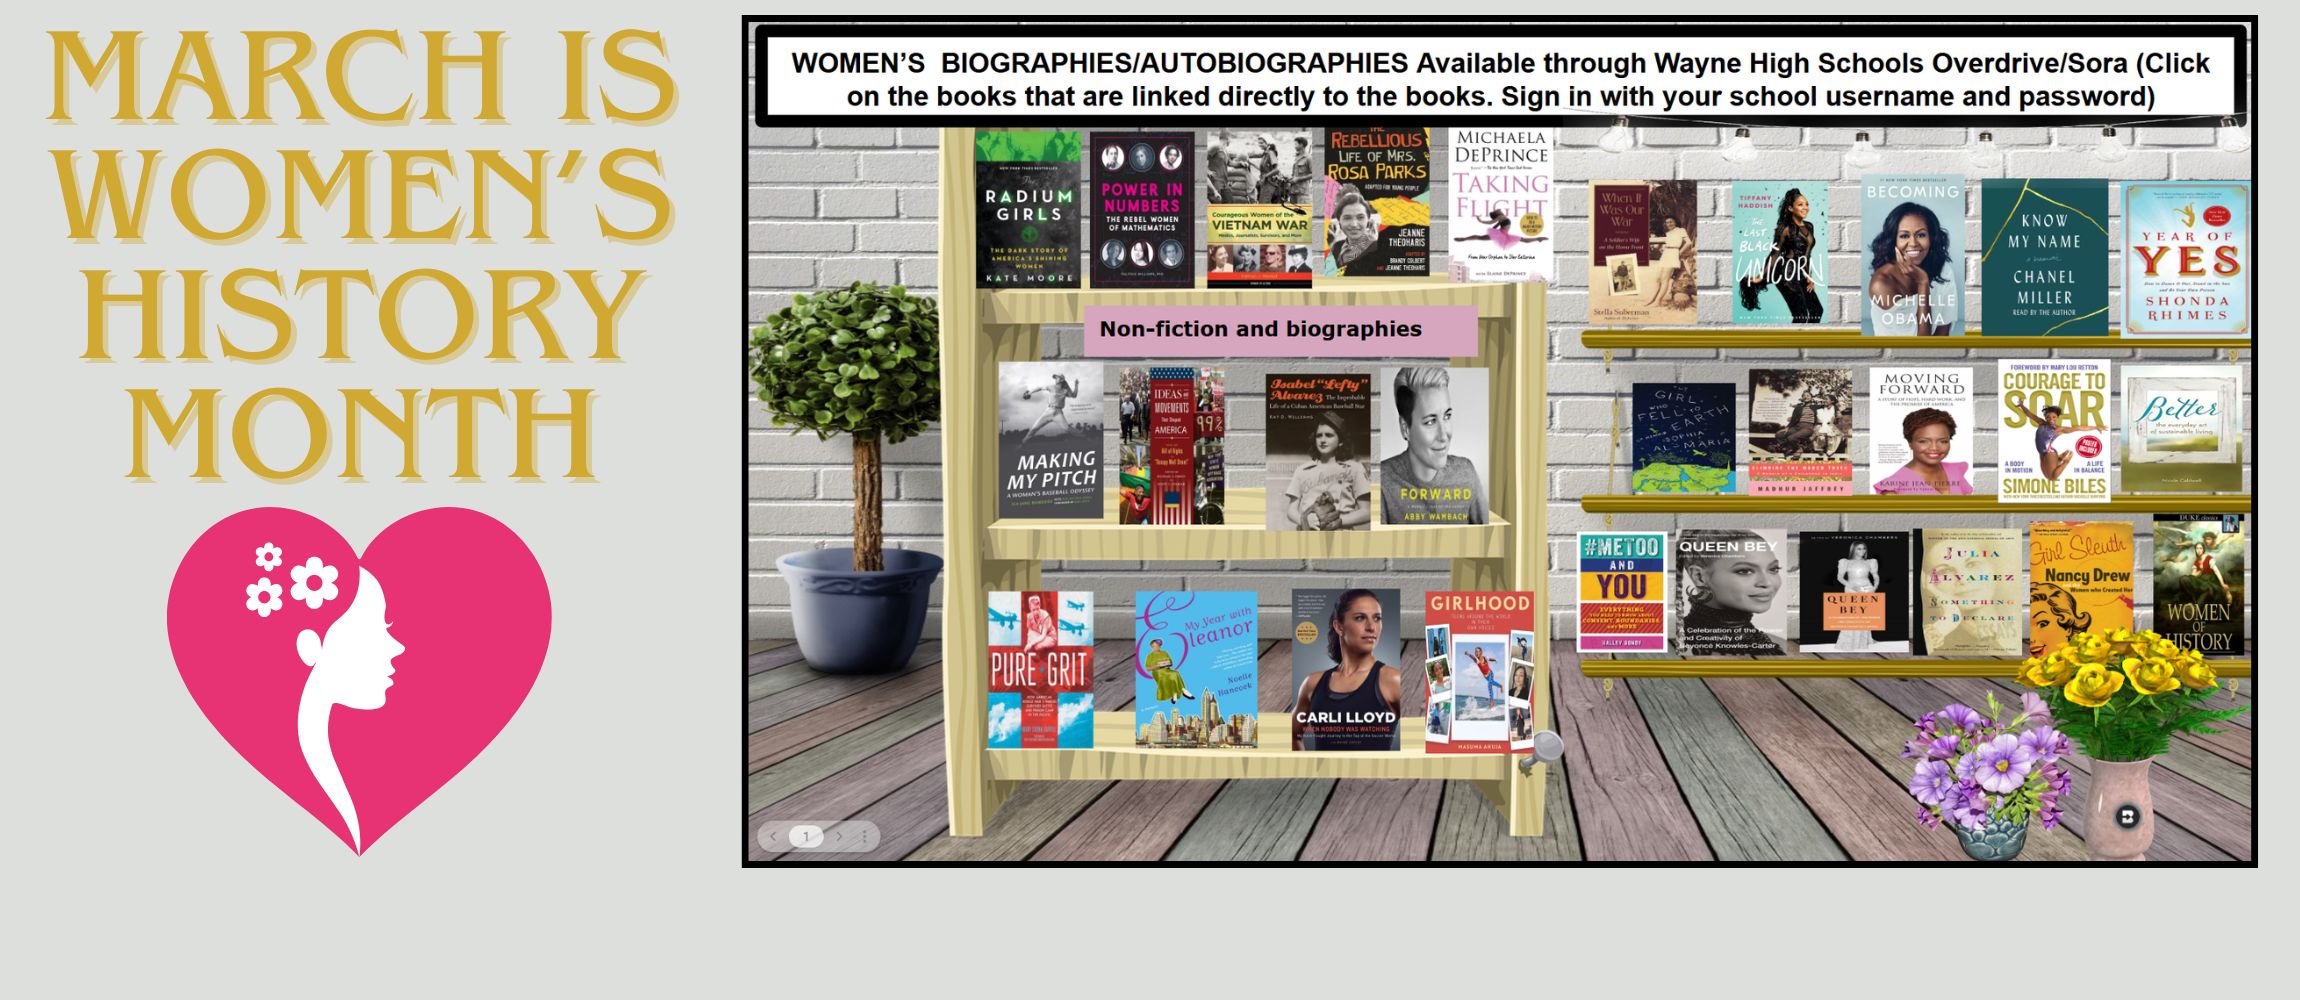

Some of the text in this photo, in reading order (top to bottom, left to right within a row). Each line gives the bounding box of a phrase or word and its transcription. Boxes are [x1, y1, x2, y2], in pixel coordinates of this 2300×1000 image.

[792, 53, 2210, 78] WOMEN’S BIOGRAPHIES/AUTOBIOGRAPHIES Available through Wayne High Schools Overdrive/Sora (Click
[46, 28, 678, 125] MARCH IS
[848, 86, 2154, 111] on the books that are linked directly to the books. Sign in with your school username and password)
[1331, 132, 1422, 149] REBELLIOUS
[1457, 131, 1546, 144] MICHAELA
[1339, 151, 1362, 162] LIFE
[1367, 152, 1382, 162] OF
[1328, 163, 1427, 179] ROSA PARKS
[1452, 172, 1549, 193] TAKING
[47, 146, 675, 245] WOMEN’S
[986, 190, 1072, 202] RADIUM
[1102, 183, 1183, 196] POWER IN
[1867, 186, 1959, 198] BECOMING
[1602, 193, 1633, 203] When
[1104, 199, 1180, 212] NUMBERS
[1457, 197, 1548, 217] FLIGHT
[1599, 204, 1645, 215] Was Our
[997, 208, 1061, 220] GIRLS
[2022, 214, 2067, 227] KNOW
[1212, 221, 1308, 230] VIETNAM WAR
[1611, 217, 1632, 227] War
[1399, 228, 1425, 237] JEANNE
[1744, 228, 1767, 237] LAST
[2142, 232, 2232, 242] YEAR OF
[1389, 238, 1425, 247] THEOHARIS
[1739, 241, 1780, 252] BLACK
[2008, 235, 2080, 248] MY NAME
[2133, 245, 2241, 277] YES
[1735, 253, 1825, 287] UNICORN
[2014, 270, 2074, 283] CHANEL
[1870, 294, 1955, 307] MICHELLE
[2018, 291, 2072, 304] MILLER
[2146, 297, 2228, 306] SHONDA
[79, 266, 652, 364] HISTORY
[1881, 312, 1945, 326] OBAMA
[2148, 311, 2227, 321] RHIMES
[1101, 320, 1422, 341] Non-fiction and biographies
[1270, 379, 1316, 389] Isabel
[1885, 374, 1959, 383] MOVING
[2003, 373, 2105, 389] COURAGE TO
[1154, 389, 1182, 399] IDEAS
[1880, 385, 1965, 394] FORWARD
[1270, 391, 1323, 404] Alvarez
[1655, 390, 1696, 404] GIRL
[1155, 403, 1189, 413] MOVEMENTS
[2003, 390, 2104, 428] SOAR
[2136, 396, 2222, 422] Better
[1638, 409, 1683, 421] FELL
[1671, 405, 1729, 431] EARTH
[1155, 426, 1187, 434] AMERICA
[1197, 416, 1223, 432] 99%
[124, 386, 599, 484] MONTH
[1017, 451, 1096, 470] MAKING
[1007, 470, 1097, 490] MY PITCH
[2003, 479, 2106, 494] SIMONE BILES
[1401, 488, 1471, 500] FORWARD
[1585, 538, 1658, 556] #METOO
[1680, 541, 1778, 552] QUEEN BEY
[2030, 533, 2126, 566] Girl Sleuth
[1943, 547, 1999, 560] JULIA
[1610, 561, 1634, 570] AND
[1930, 568, 2014, 586] ALVAREZ
[2045, 568, 2130, 586] Nancy Drew
[1597, 574, 1646, 599] YOU
[1431, 596, 1530, 611] GIRLHOOD
[1828, 596, 1878, 604] QUEEN
[1929, 596, 2014, 608] SOMETHING
[1952, 614, 2014, 622] DECLARE
[2168, 603, 2231, 621] WOMEN
[1184, 607, 1252, 631] My Year with
[2193, 621, 2206, 632] OF
[2166, 633, 2233, 651] HISTORY
[992, 652, 1087, 686] PURE GRIT
[1227, 672, 1252, 684] Noelle
[1217, 683, 1252, 696] Hancock
[1296, 712, 1396, 723] CARLI LLOYD
